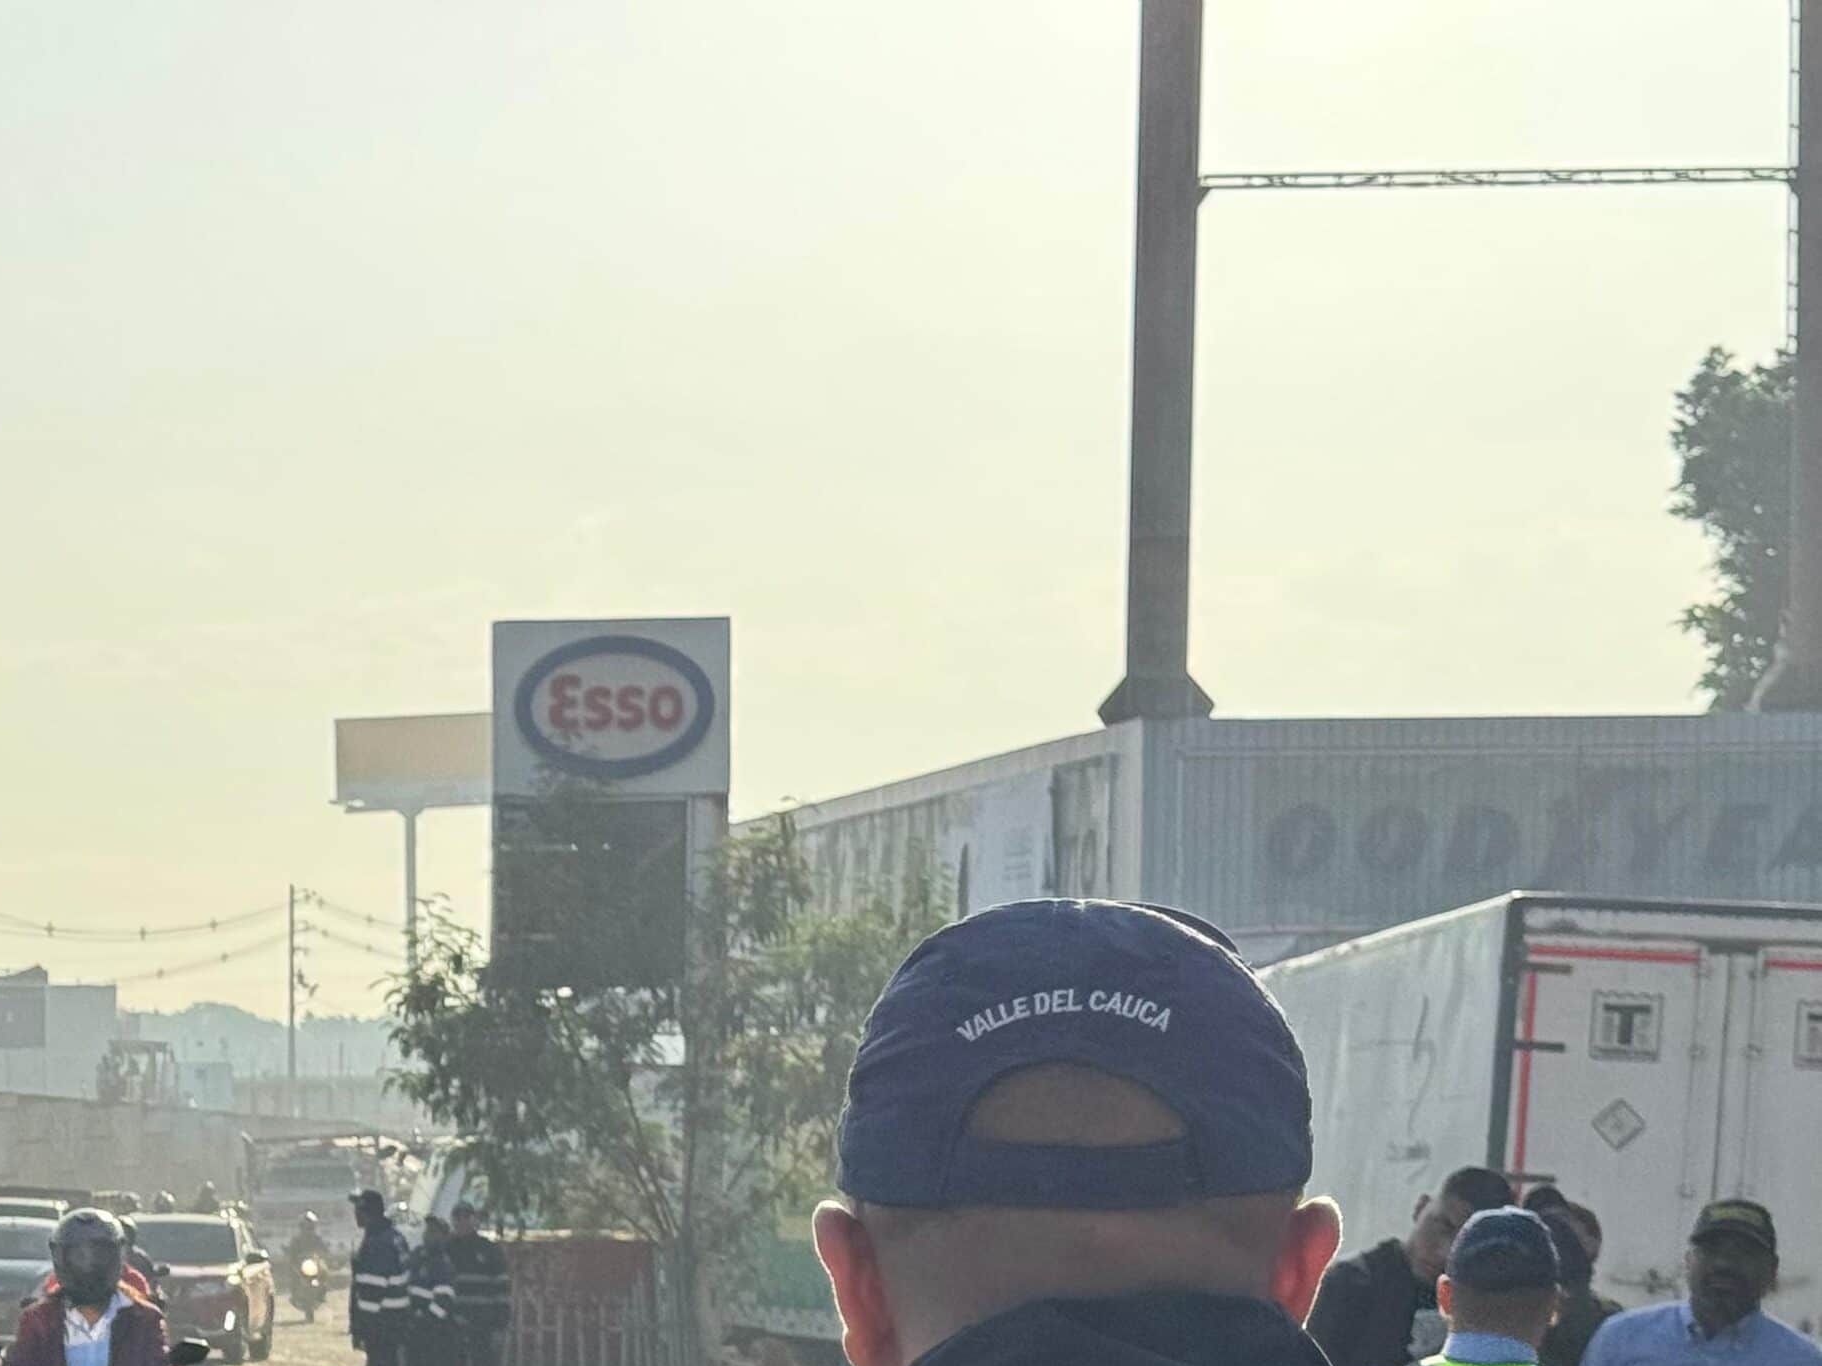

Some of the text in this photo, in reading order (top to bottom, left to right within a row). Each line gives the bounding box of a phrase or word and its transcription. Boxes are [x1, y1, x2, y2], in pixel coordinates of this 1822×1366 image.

[956, 989, 1171, 1041] VALLE DEL CAUCA
